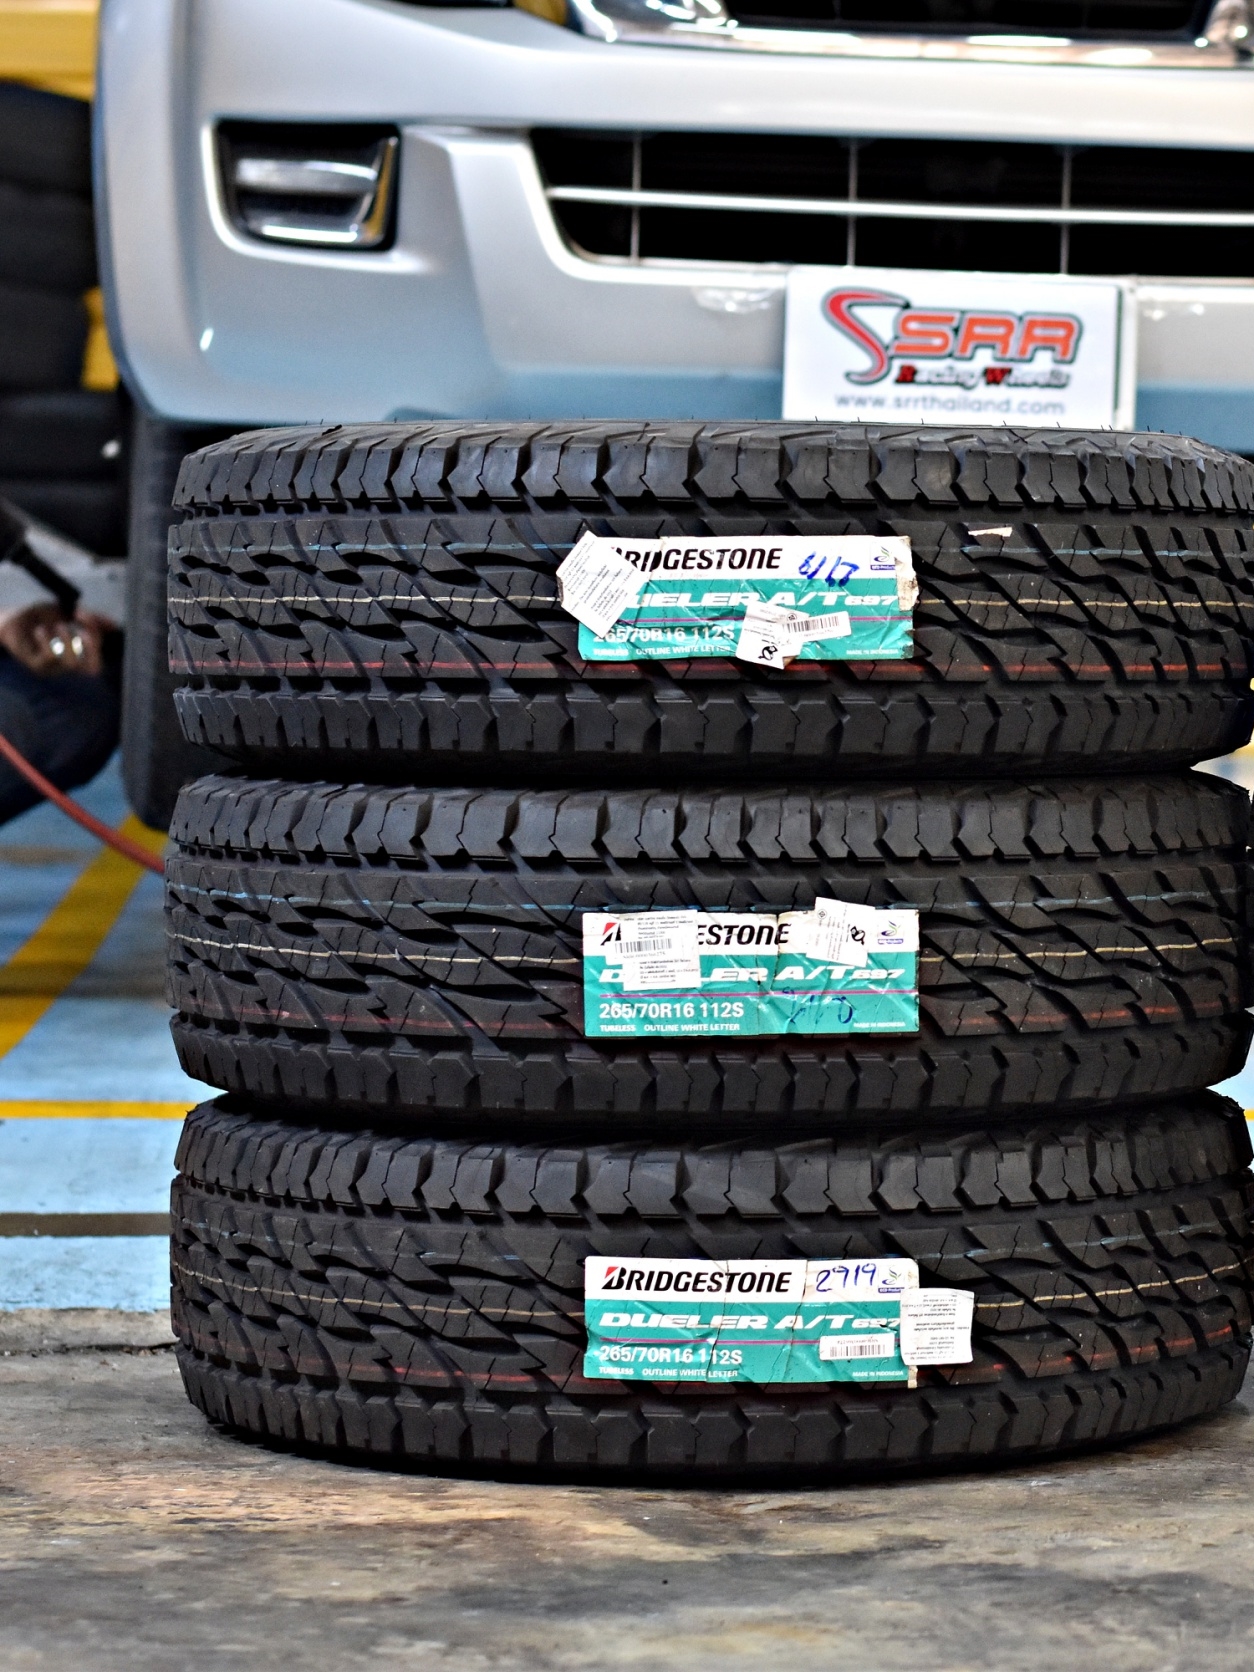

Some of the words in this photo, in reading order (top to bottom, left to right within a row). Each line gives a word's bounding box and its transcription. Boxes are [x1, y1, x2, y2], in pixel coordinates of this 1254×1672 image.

[834, 394, 1066, 415] www.srrthailand.com
[616, 547, 783, 573] RIDGESTONE
[691, 625, 735, 641] 112S
[775, 965, 856, 980] A/T
[599, 1003, 694, 1018] 265/70R16
[700, 1002, 744, 1017] 112S
[710, 1023, 740, 1031] LETTER
[601, 1266, 792, 1293] BRIDGESTONE
[599, 1312, 768, 1329] DUELER
[774, 1315, 854, 1329] A/T
[600, 1346, 694, 1364] 265/70R16
[700, 1348, 743, 1365] 112S
[642, 1368, 678, 1377] OUTLINE
[680, 1369, 706, 1377] WHITE
